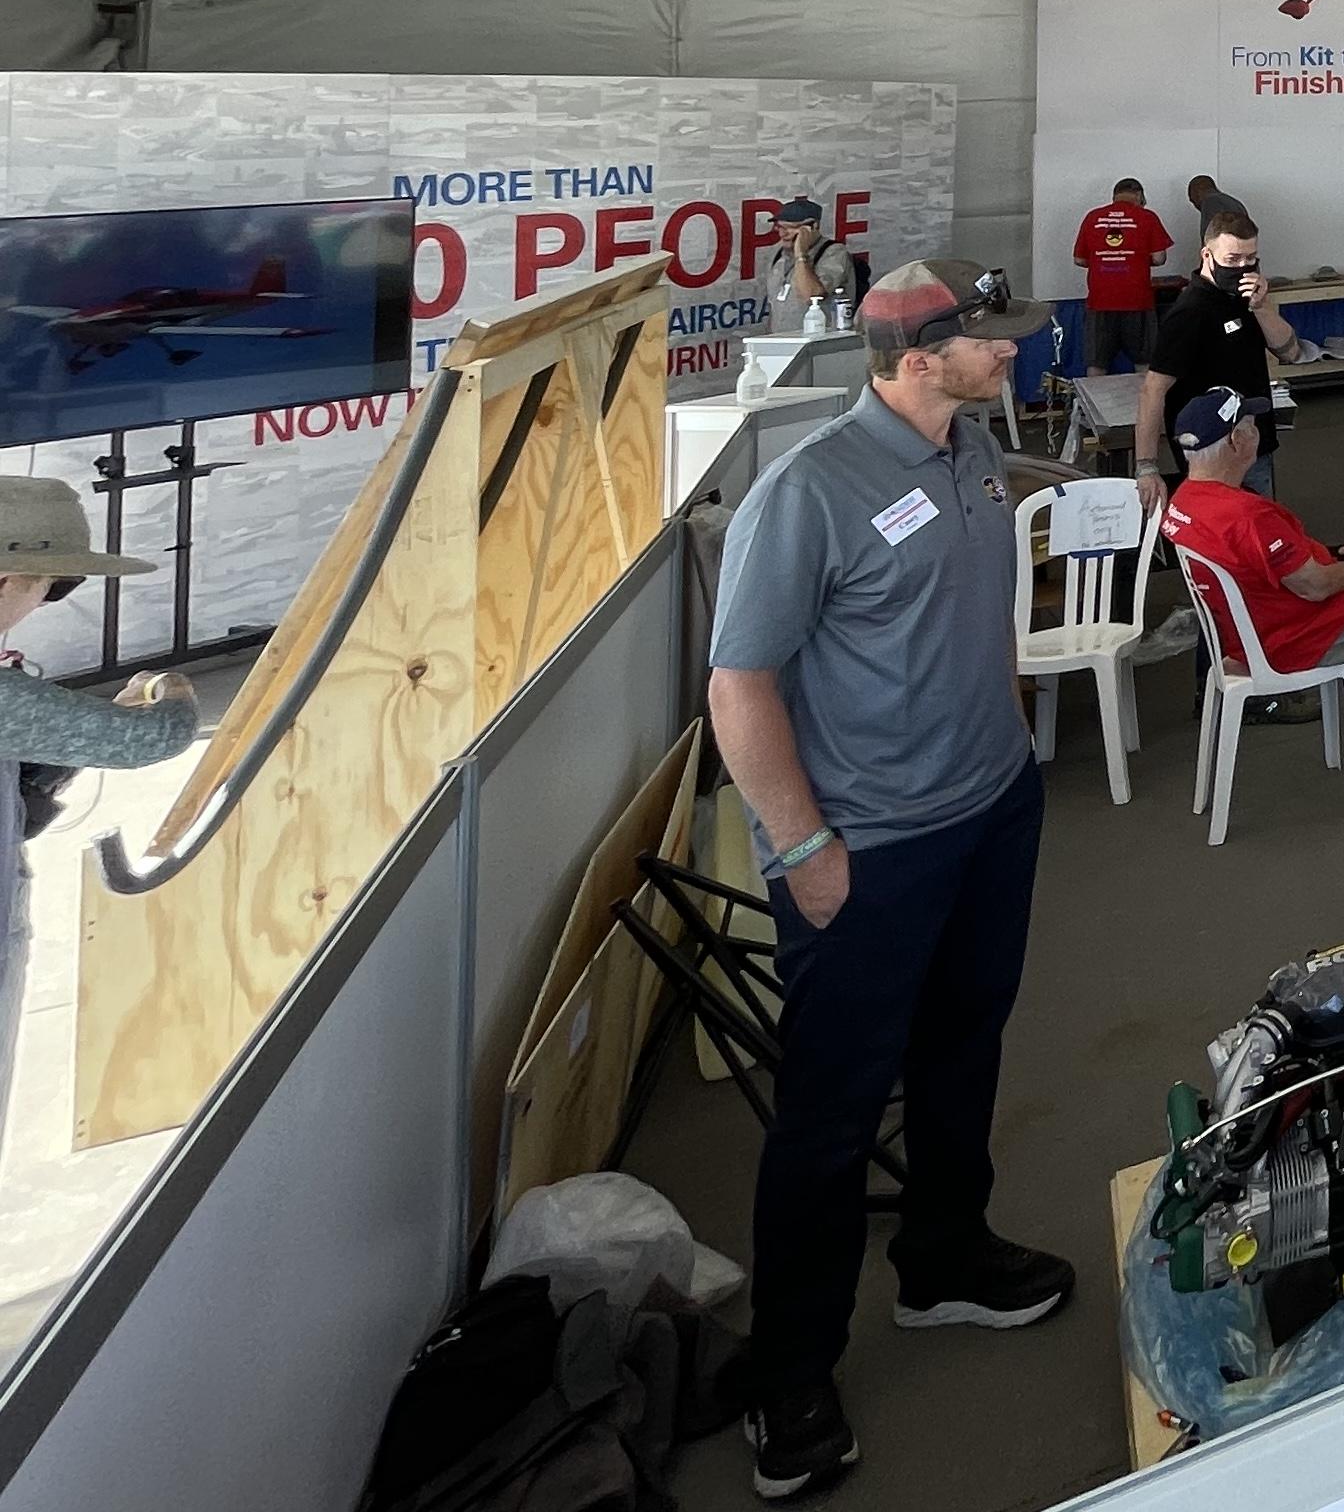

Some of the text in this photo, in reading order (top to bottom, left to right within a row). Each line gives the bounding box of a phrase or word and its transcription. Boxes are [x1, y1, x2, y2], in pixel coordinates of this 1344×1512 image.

[1232, 47, 1290, 67] From
[1300, 46, 1334, 66] Kit
[394, 165, 654, 207] MORE THAN
[513, 191, 872, 301] PEOPE
[254, 394, 391, 445] NOW
